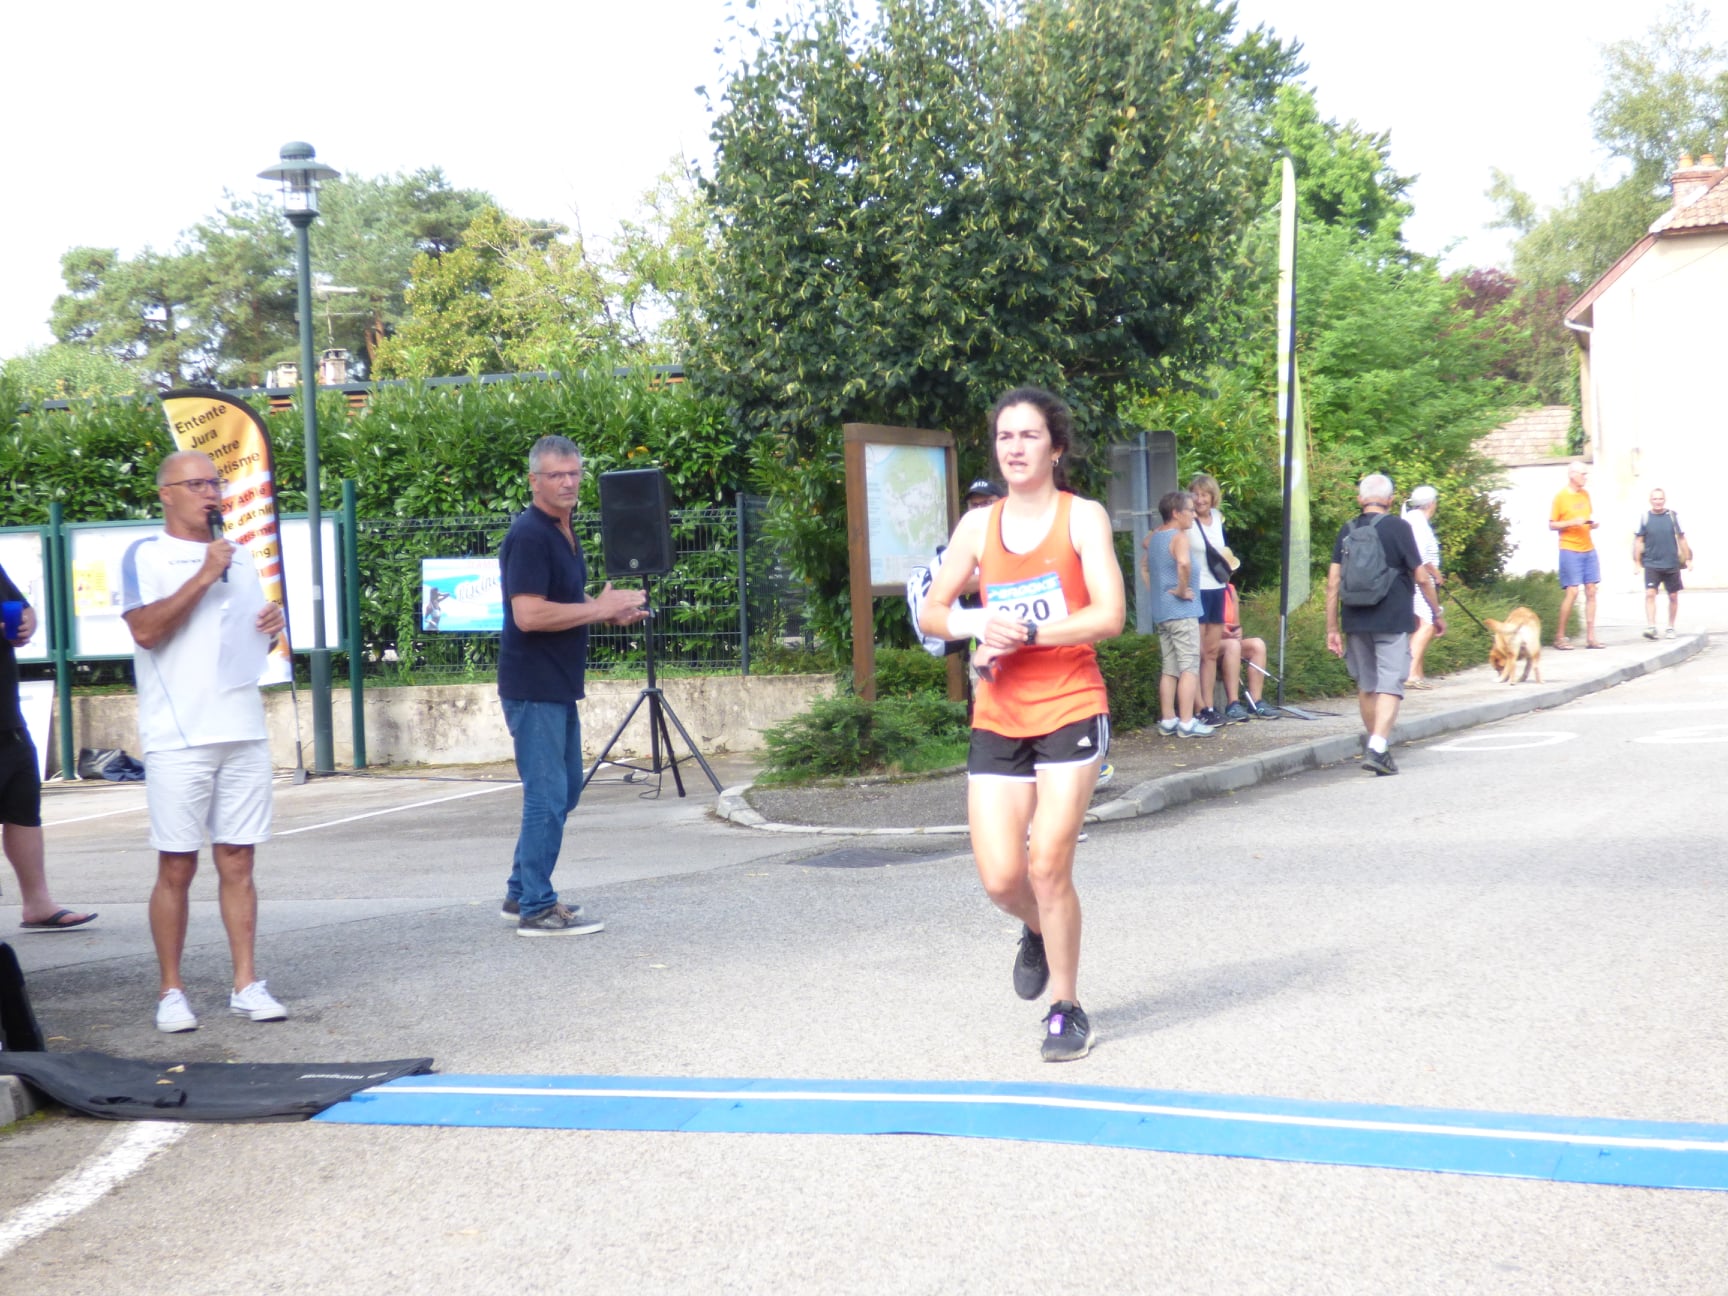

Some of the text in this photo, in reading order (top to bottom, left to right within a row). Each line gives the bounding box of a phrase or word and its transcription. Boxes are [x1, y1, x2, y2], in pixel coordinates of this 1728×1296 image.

[174, 404, 227, 434] Entente
[190, 428, 218, 449] Jura
[208, 439, 240, 461] entre
[998, 599, 1050, 622] 20
